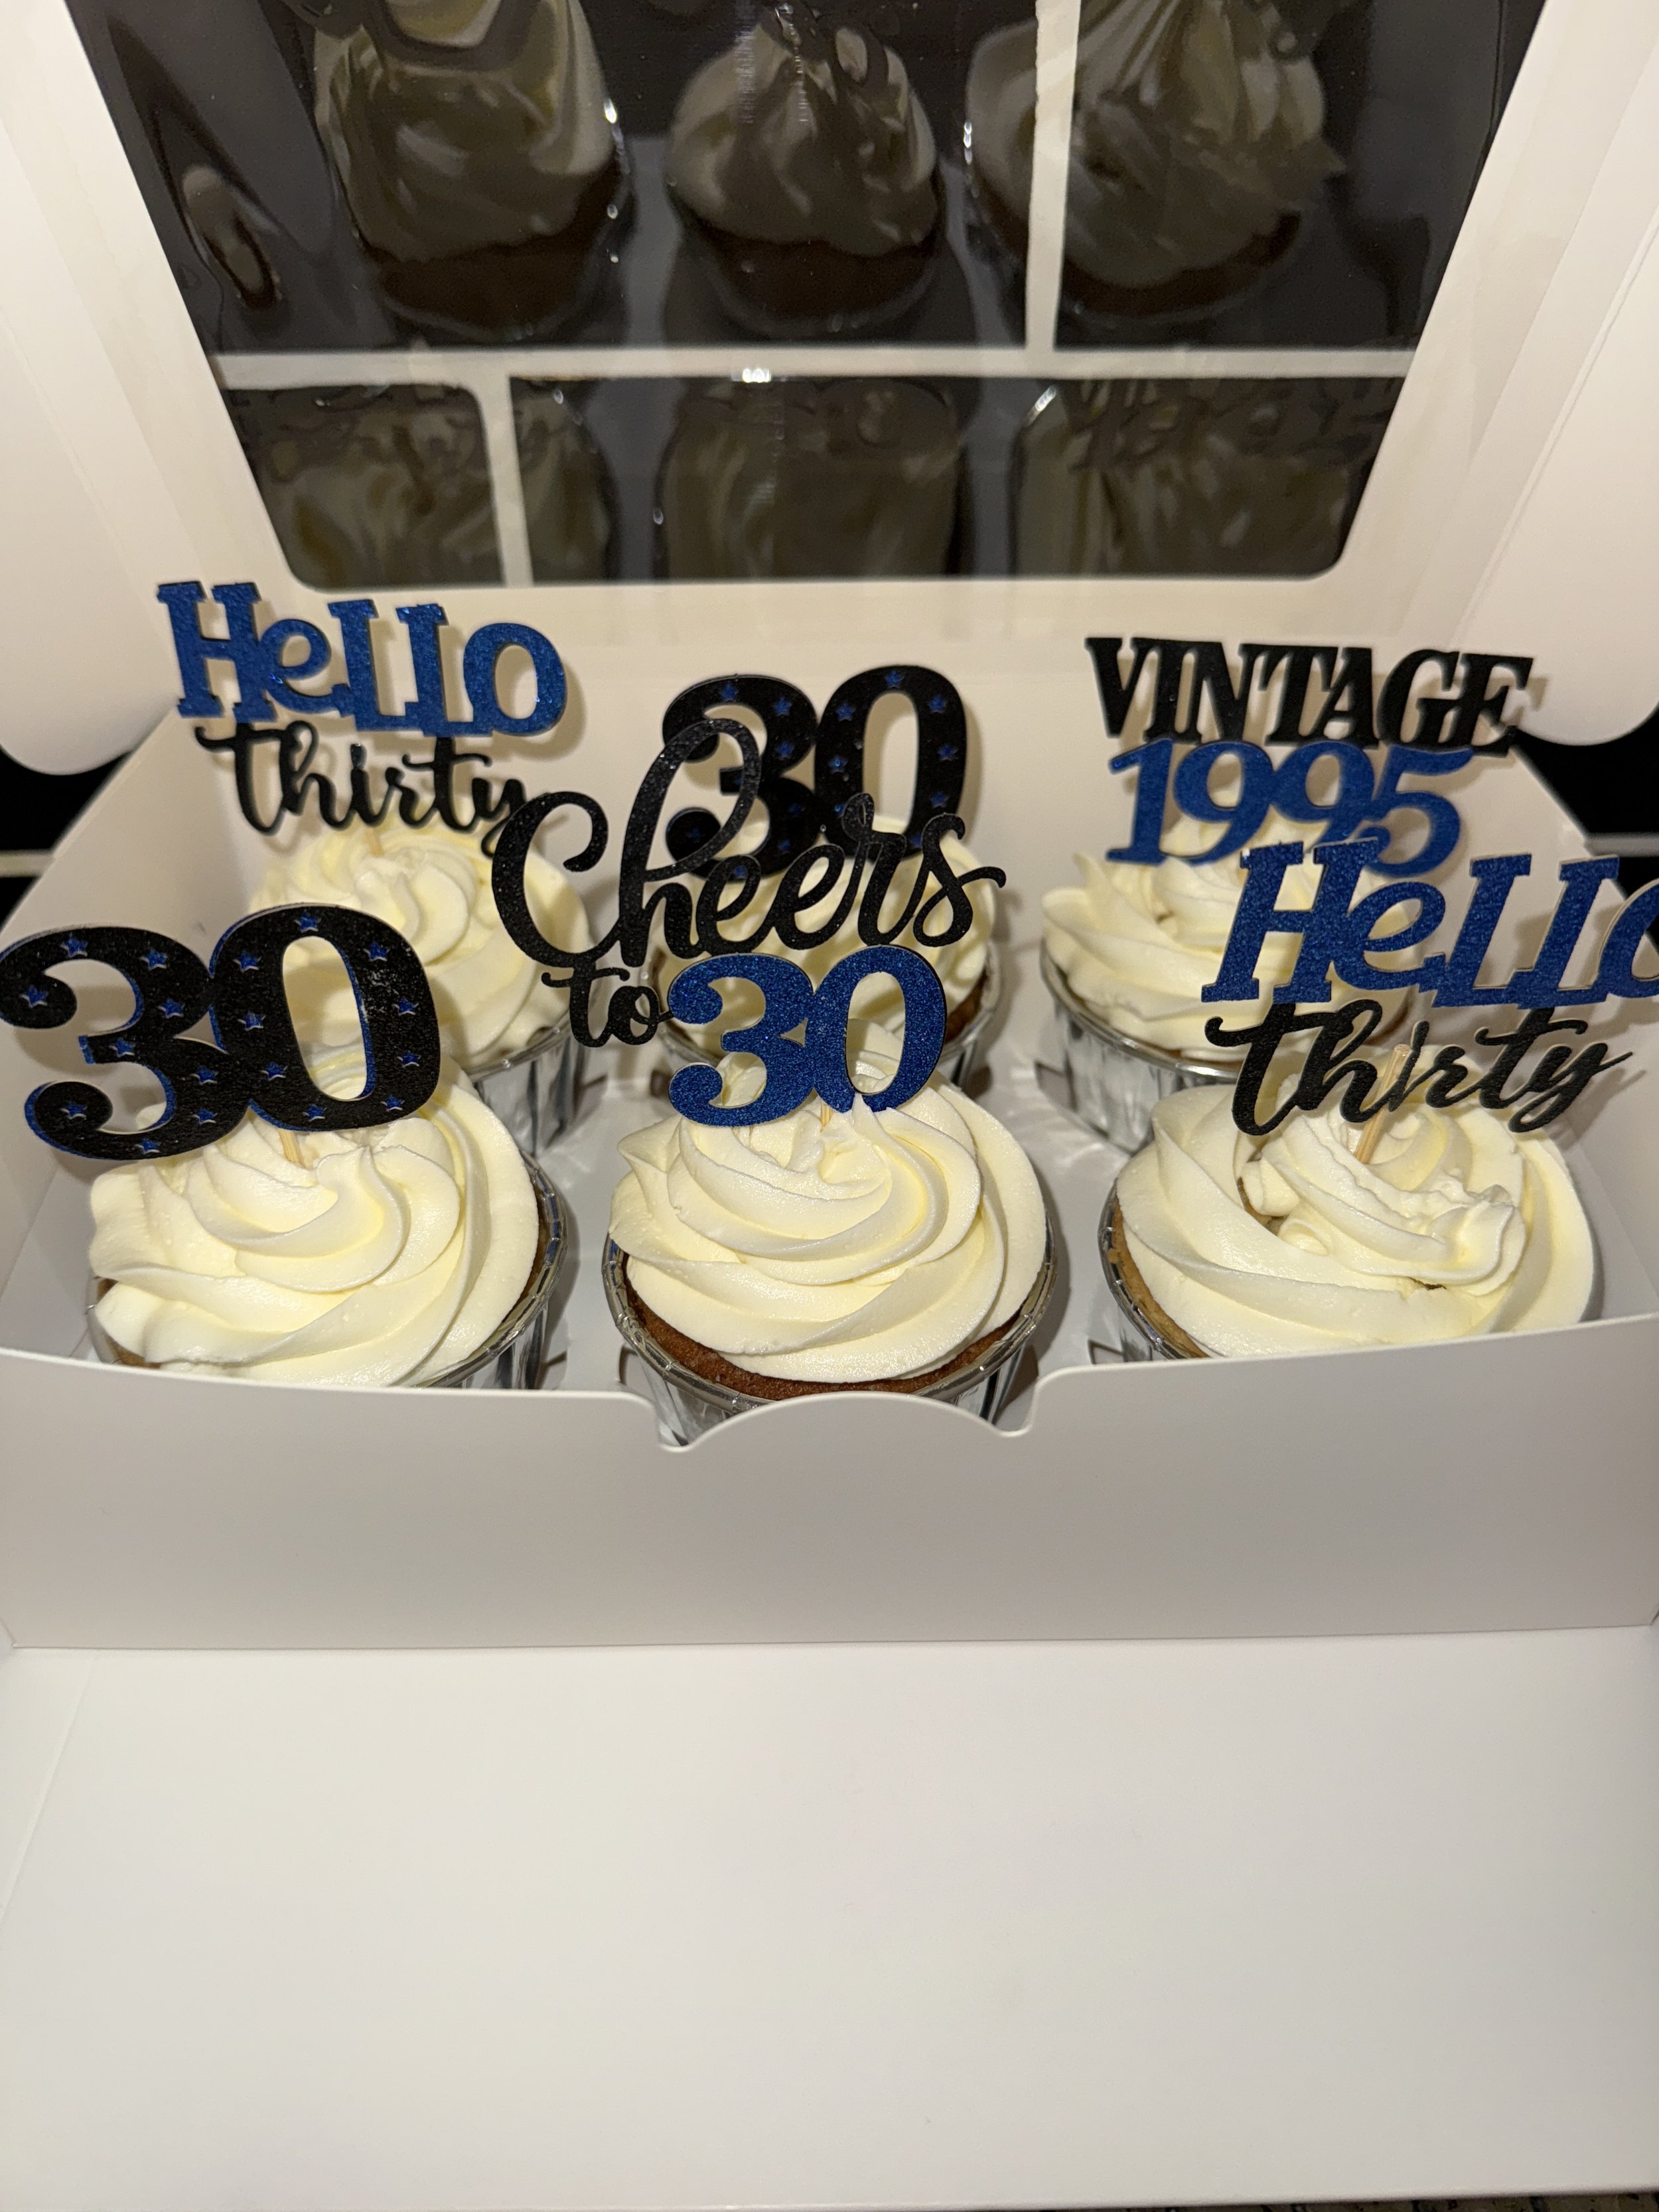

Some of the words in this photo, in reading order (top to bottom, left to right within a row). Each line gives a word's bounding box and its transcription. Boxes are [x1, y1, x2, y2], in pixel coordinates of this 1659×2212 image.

[662, 664, 967, 879] 30
[1086, 638, 1534, 757] VINTAGE
[194, 719, 531, 856] thirty
[1106, 738, 1475, 877] 1995
[492, 791, 1007, 968] Cheers
[0, 902, 441, 1160] 30
[541, 957, 672, 1047] to
[668, 944, 948, 1128] 30
[1204, 999, 1633, 1136] thirty
